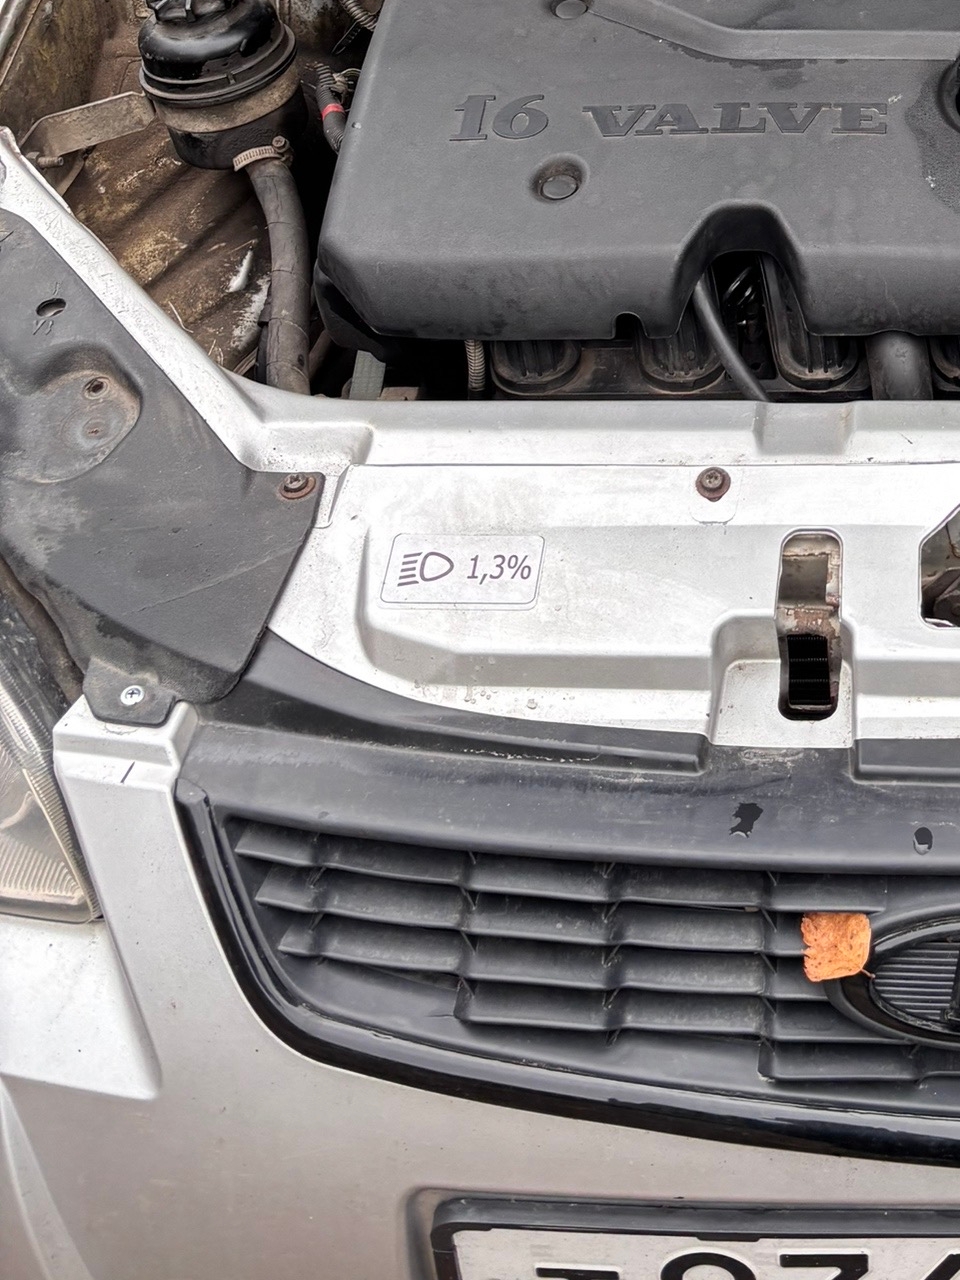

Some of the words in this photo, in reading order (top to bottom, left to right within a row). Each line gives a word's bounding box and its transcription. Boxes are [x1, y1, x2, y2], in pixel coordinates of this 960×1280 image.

[449, 93, 549, 141] 16
[582, 101, 888, 137] VALVE
[466, 554, 532, 586] 1,3%
